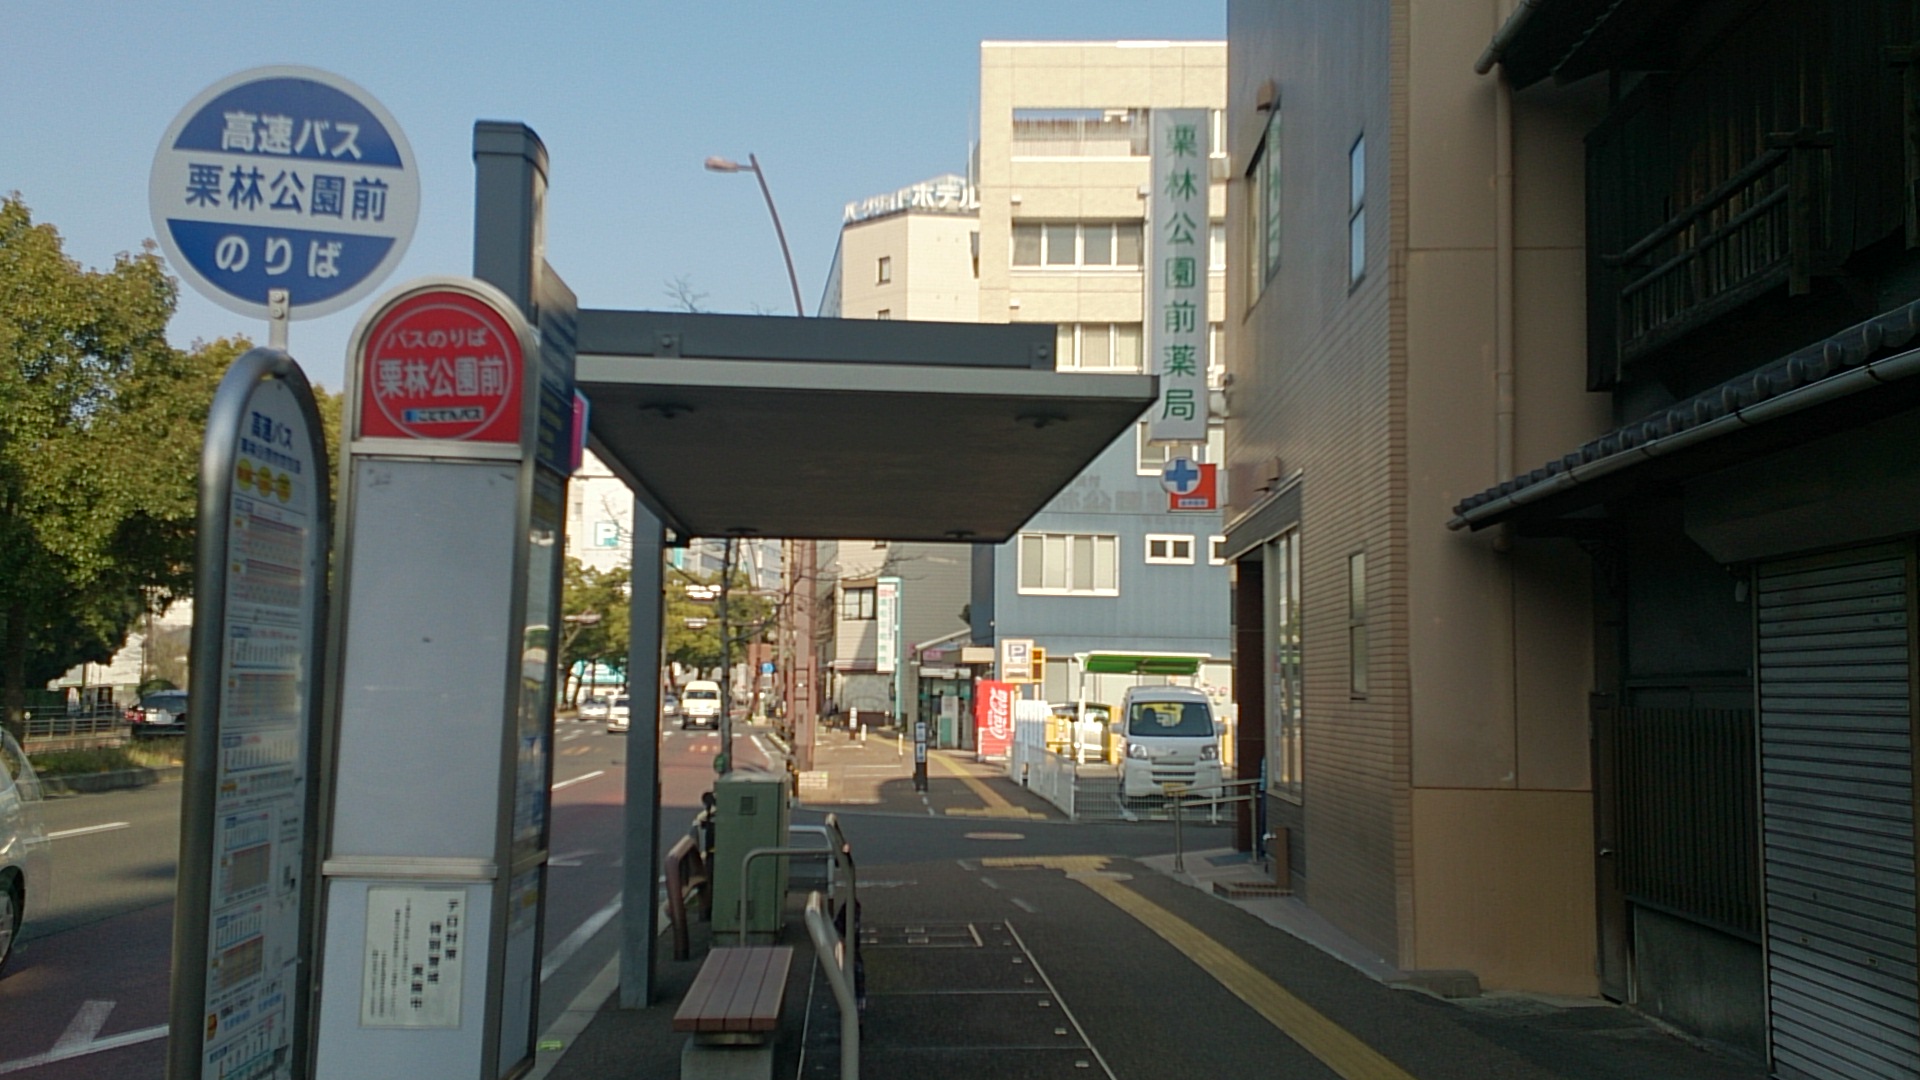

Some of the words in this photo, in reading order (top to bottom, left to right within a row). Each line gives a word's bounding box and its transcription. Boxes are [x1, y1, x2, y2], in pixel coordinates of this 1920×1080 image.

[221, 111, 363, 160] 高速バス
[185, 162, 389, 223] 栗林公園前
[215, 235, 342, 279] のりば
[1161, 123, 1197, 421] 栗林公園前薬局
[387, 327, 488, 349] バスのりば
[377, 356, 505, 399] 栗林公園前
[251, 410, 293, 451] 高速バス
[446, 900, 459, 960] テロ対策
